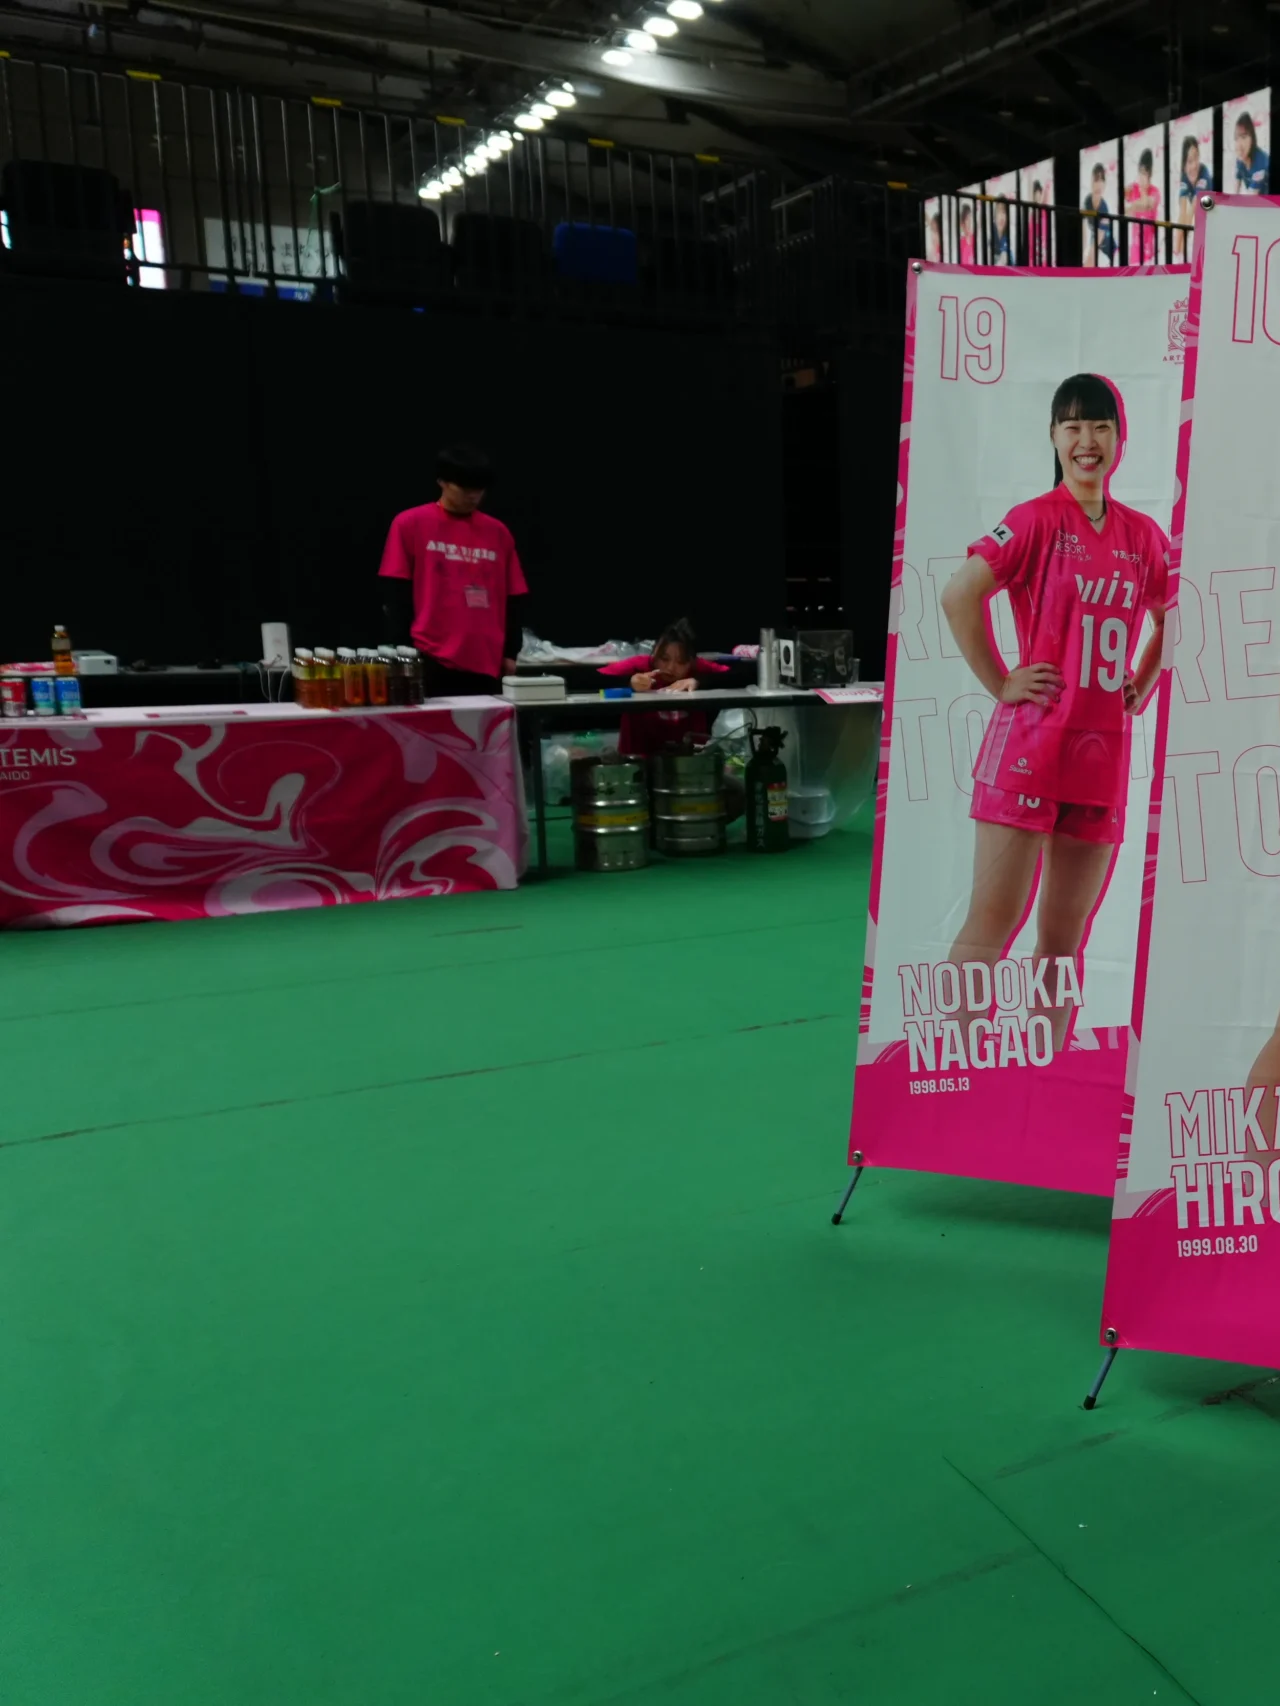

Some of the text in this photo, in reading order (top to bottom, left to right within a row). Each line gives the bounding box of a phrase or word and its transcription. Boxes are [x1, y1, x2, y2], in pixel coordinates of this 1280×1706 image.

[938, 296, 1006, 384] 19
[1079, 614, 1128, 693] 19
[898, 956, 1084, 1017] NODOKA
[903, 1015, 1054, 1073] NAGAO
[909, 1077, 970, 1095] 1998.05.13
[1177, 1235, 1258, 1258] 1999.08.30
